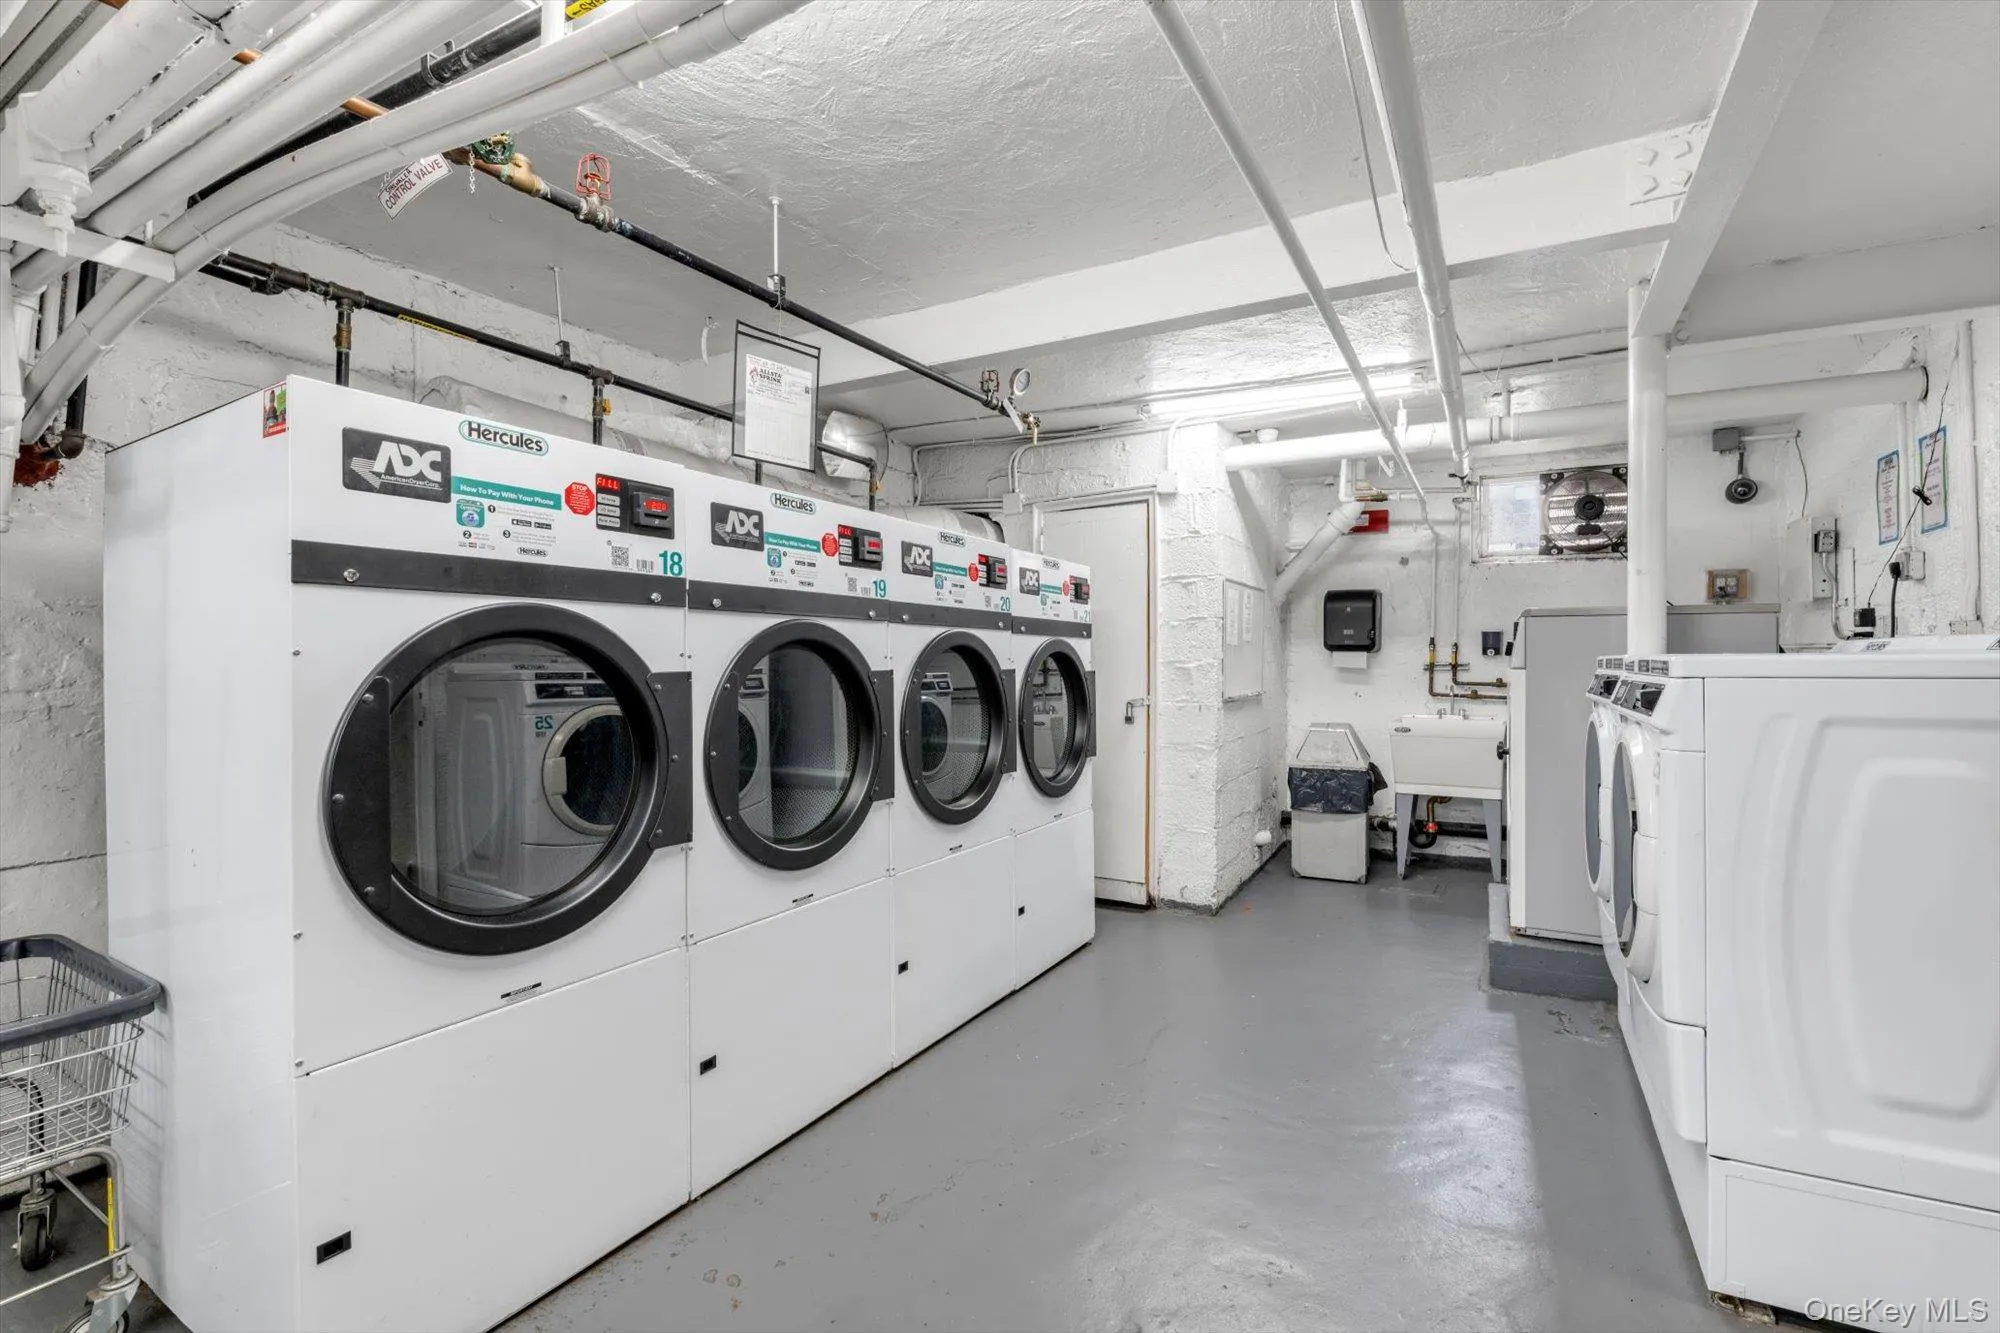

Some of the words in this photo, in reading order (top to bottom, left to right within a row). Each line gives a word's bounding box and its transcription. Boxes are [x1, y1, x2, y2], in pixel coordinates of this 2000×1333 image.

[385, 178, 416, 210] CONTROL
[414, 158, 443, 180] VALVE
[467, 421, 543, 452] Hercules
[373, 440, 442, 482] ADC
[460, 484, 479, 493] How
[479, 486, 487, 494] To
[488, 488, 500, 497] Pay
[501, 490, 517, 499] With
[519, 493, 533, 502] Your
[534, 496, 554, 506] Phone
[774, 493, 814, 513] Hercules
[726, 510, 760, 537] ADC
[519, 547, 547, 557] Hercules
[659, 550, 683, 577] 18
[873, 579, 887, 598] 19
[1000, 596, 1010, 611] 20
